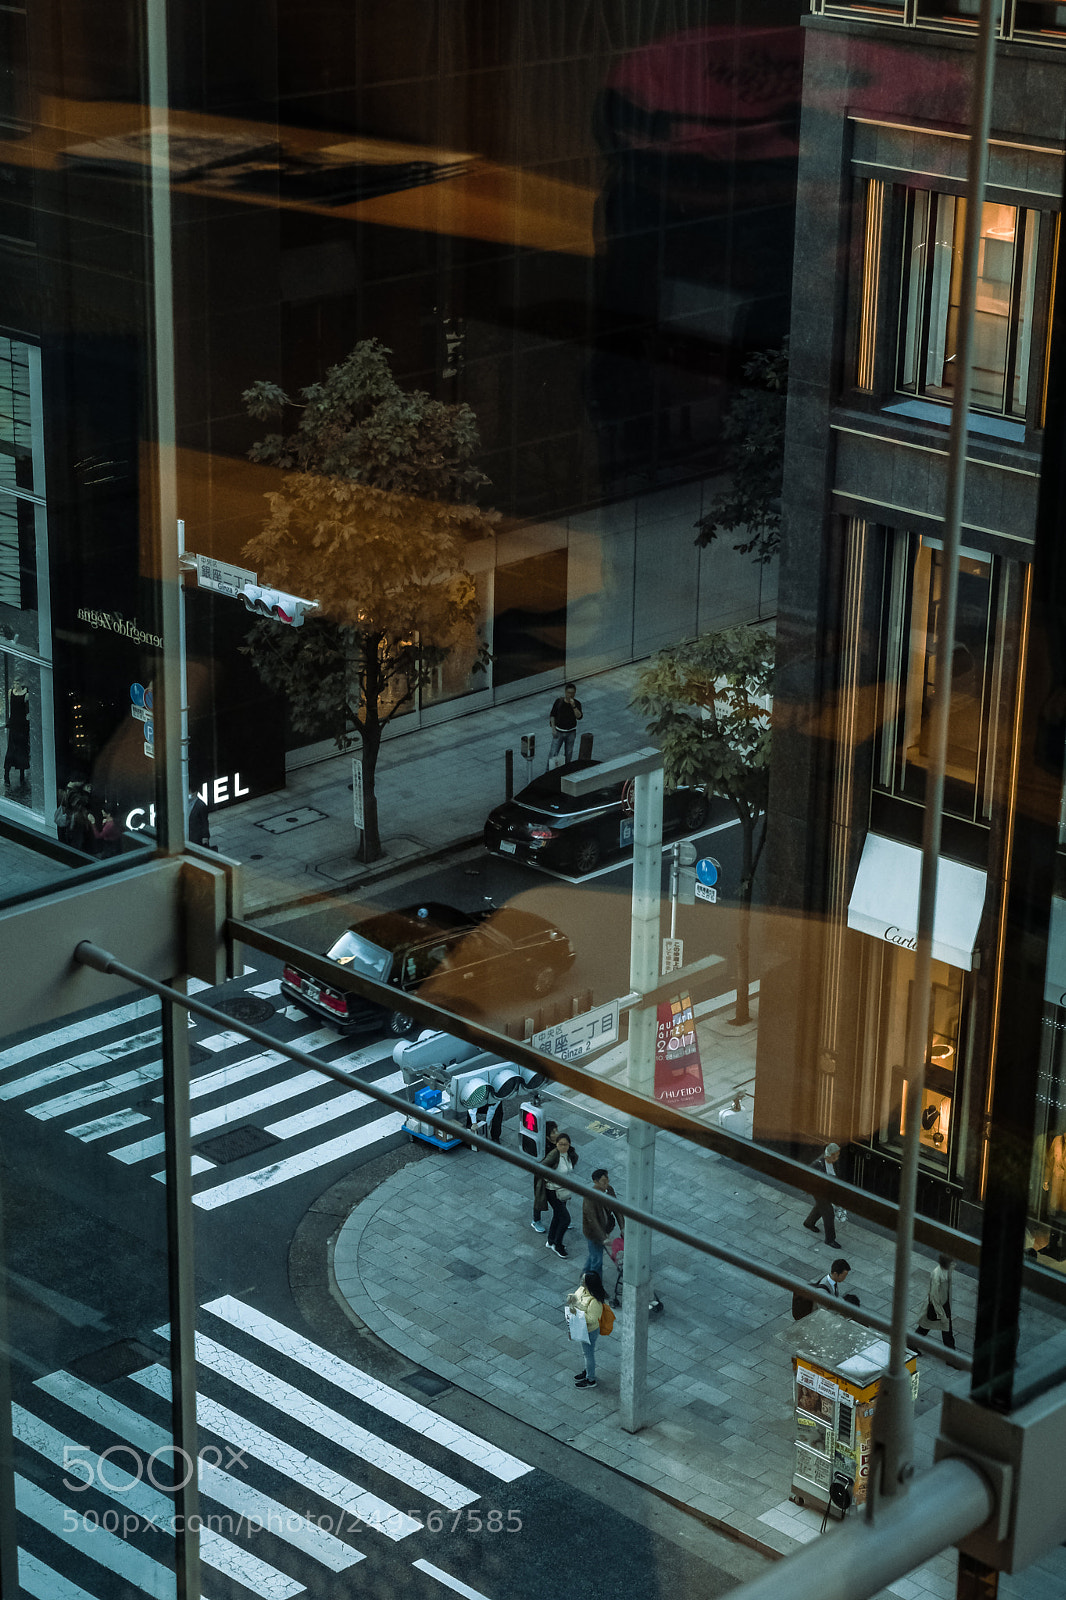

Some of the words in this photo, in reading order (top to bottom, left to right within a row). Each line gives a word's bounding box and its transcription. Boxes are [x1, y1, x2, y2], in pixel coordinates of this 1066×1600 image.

[217, 582, 233, 594] Ginza
[538, 1025, 563, 1041] 中央区
[539, 1013, 613, 1055] 銀座二丁目
[657, 1031, 694, 1053] 2017
[561, 1046, 583, 1061] Ginza
[585, 1041, 591, 1052] 2
[657, 1086, 702, 1100] SHISEIDO
